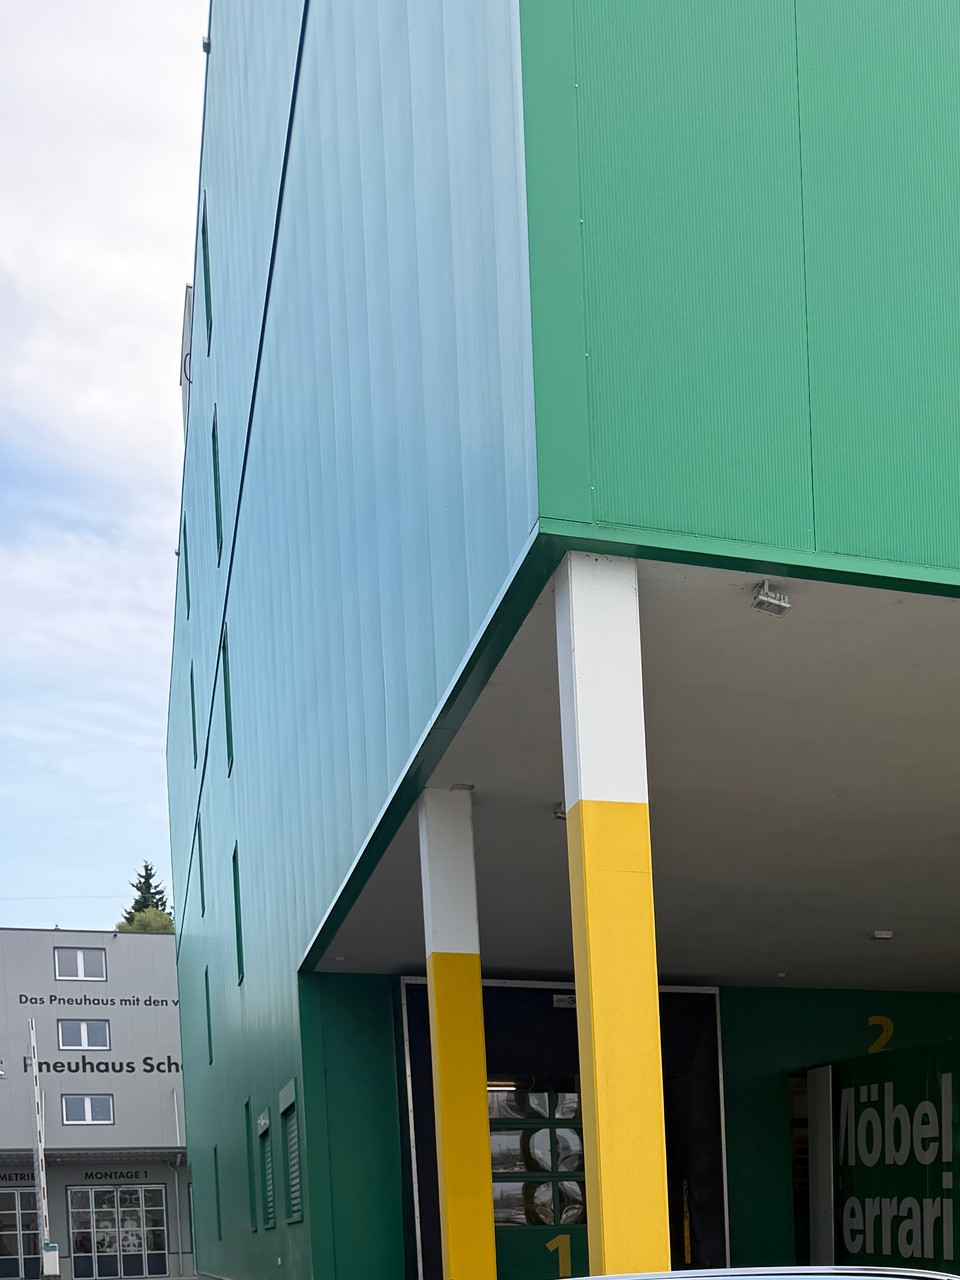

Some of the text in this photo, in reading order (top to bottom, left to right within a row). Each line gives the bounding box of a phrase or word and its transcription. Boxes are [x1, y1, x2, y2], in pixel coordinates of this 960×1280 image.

[19, 994, 45, 1005] Das
[49, 994, 116, 1006] Pneuhaus
[120, 995, 141, 1006] mit
[144, 995, 168, 1007] den
[867, 1015, 895, 1055] 2
[142, 1055, 184, 1074] Sch
[84, 1171, 141, 1181] MONTAGE
[838, 1171, 955, 1262] errari
[545, 1234, 572, 1277] 1
